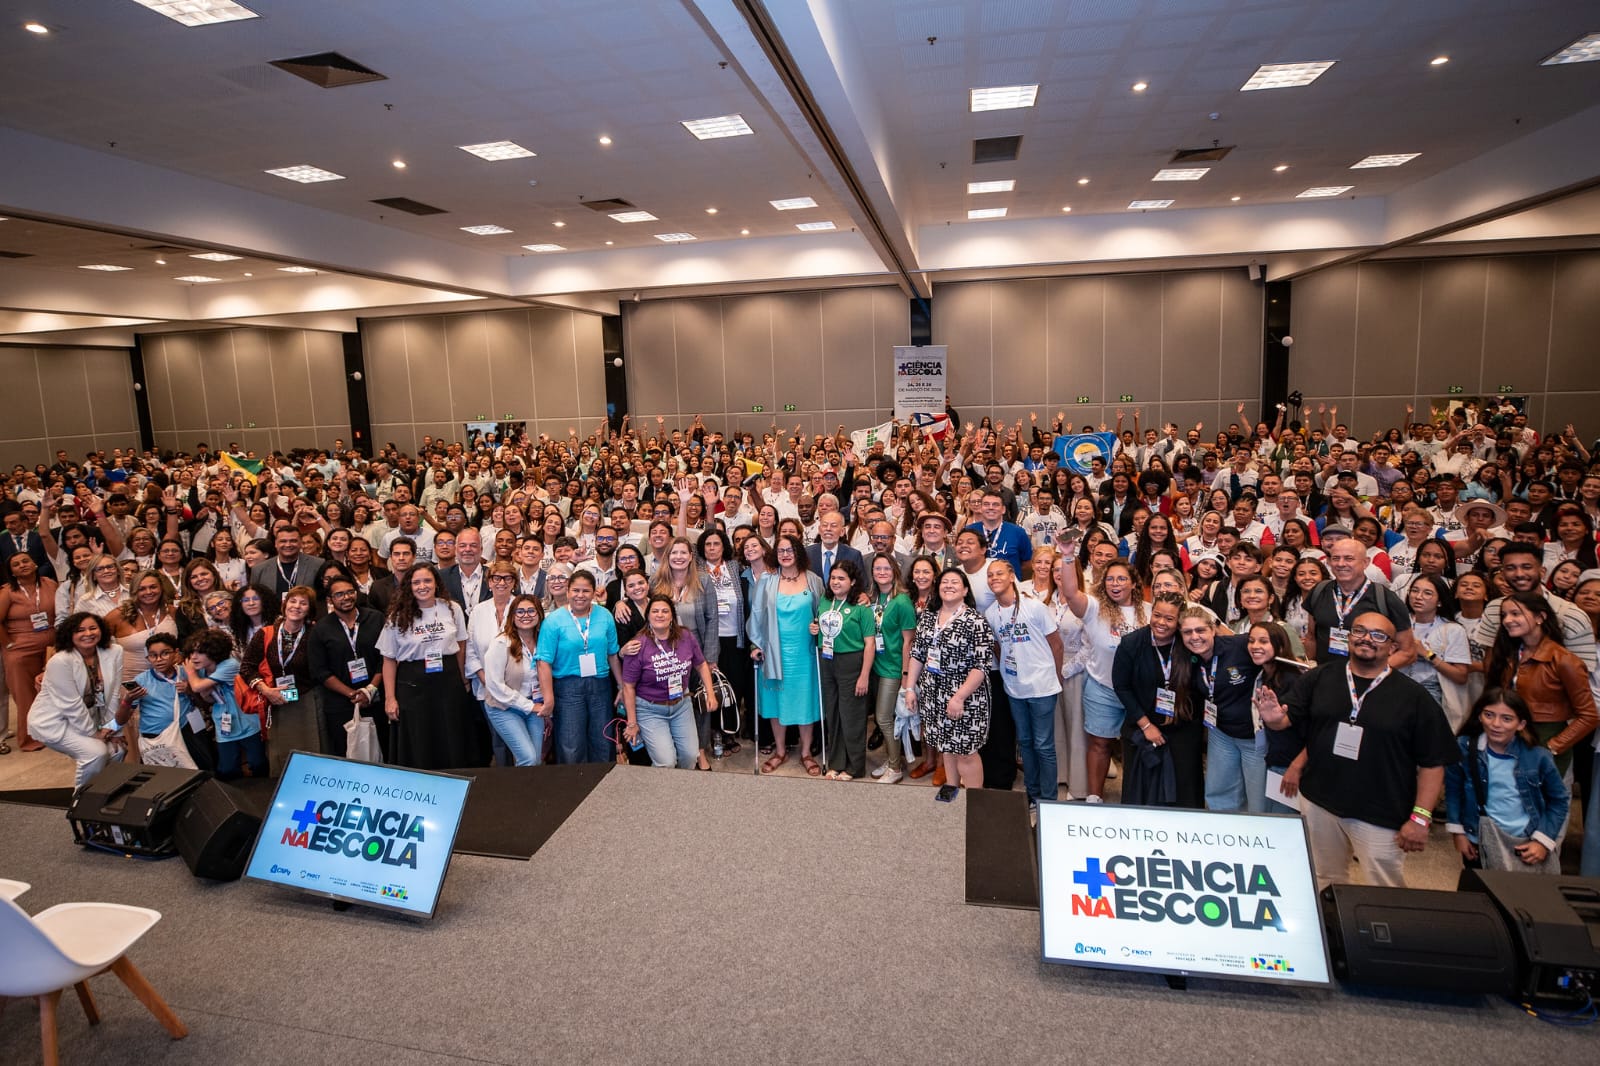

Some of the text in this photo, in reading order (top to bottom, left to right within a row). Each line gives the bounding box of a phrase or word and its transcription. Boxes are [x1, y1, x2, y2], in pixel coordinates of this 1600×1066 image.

[303, 774, 438, 806] ENCONTRO NACIONAL
[307, 827, 418, 870] ESCOLA
[1067, 824, 1276, 850] ENCONTRO NACIONAL
[1113, 888, 1288, 932] ESCOLA
[1084, 946, 1106, 955] CNPq
[1250, 956, 1295, 972] BRASIL
